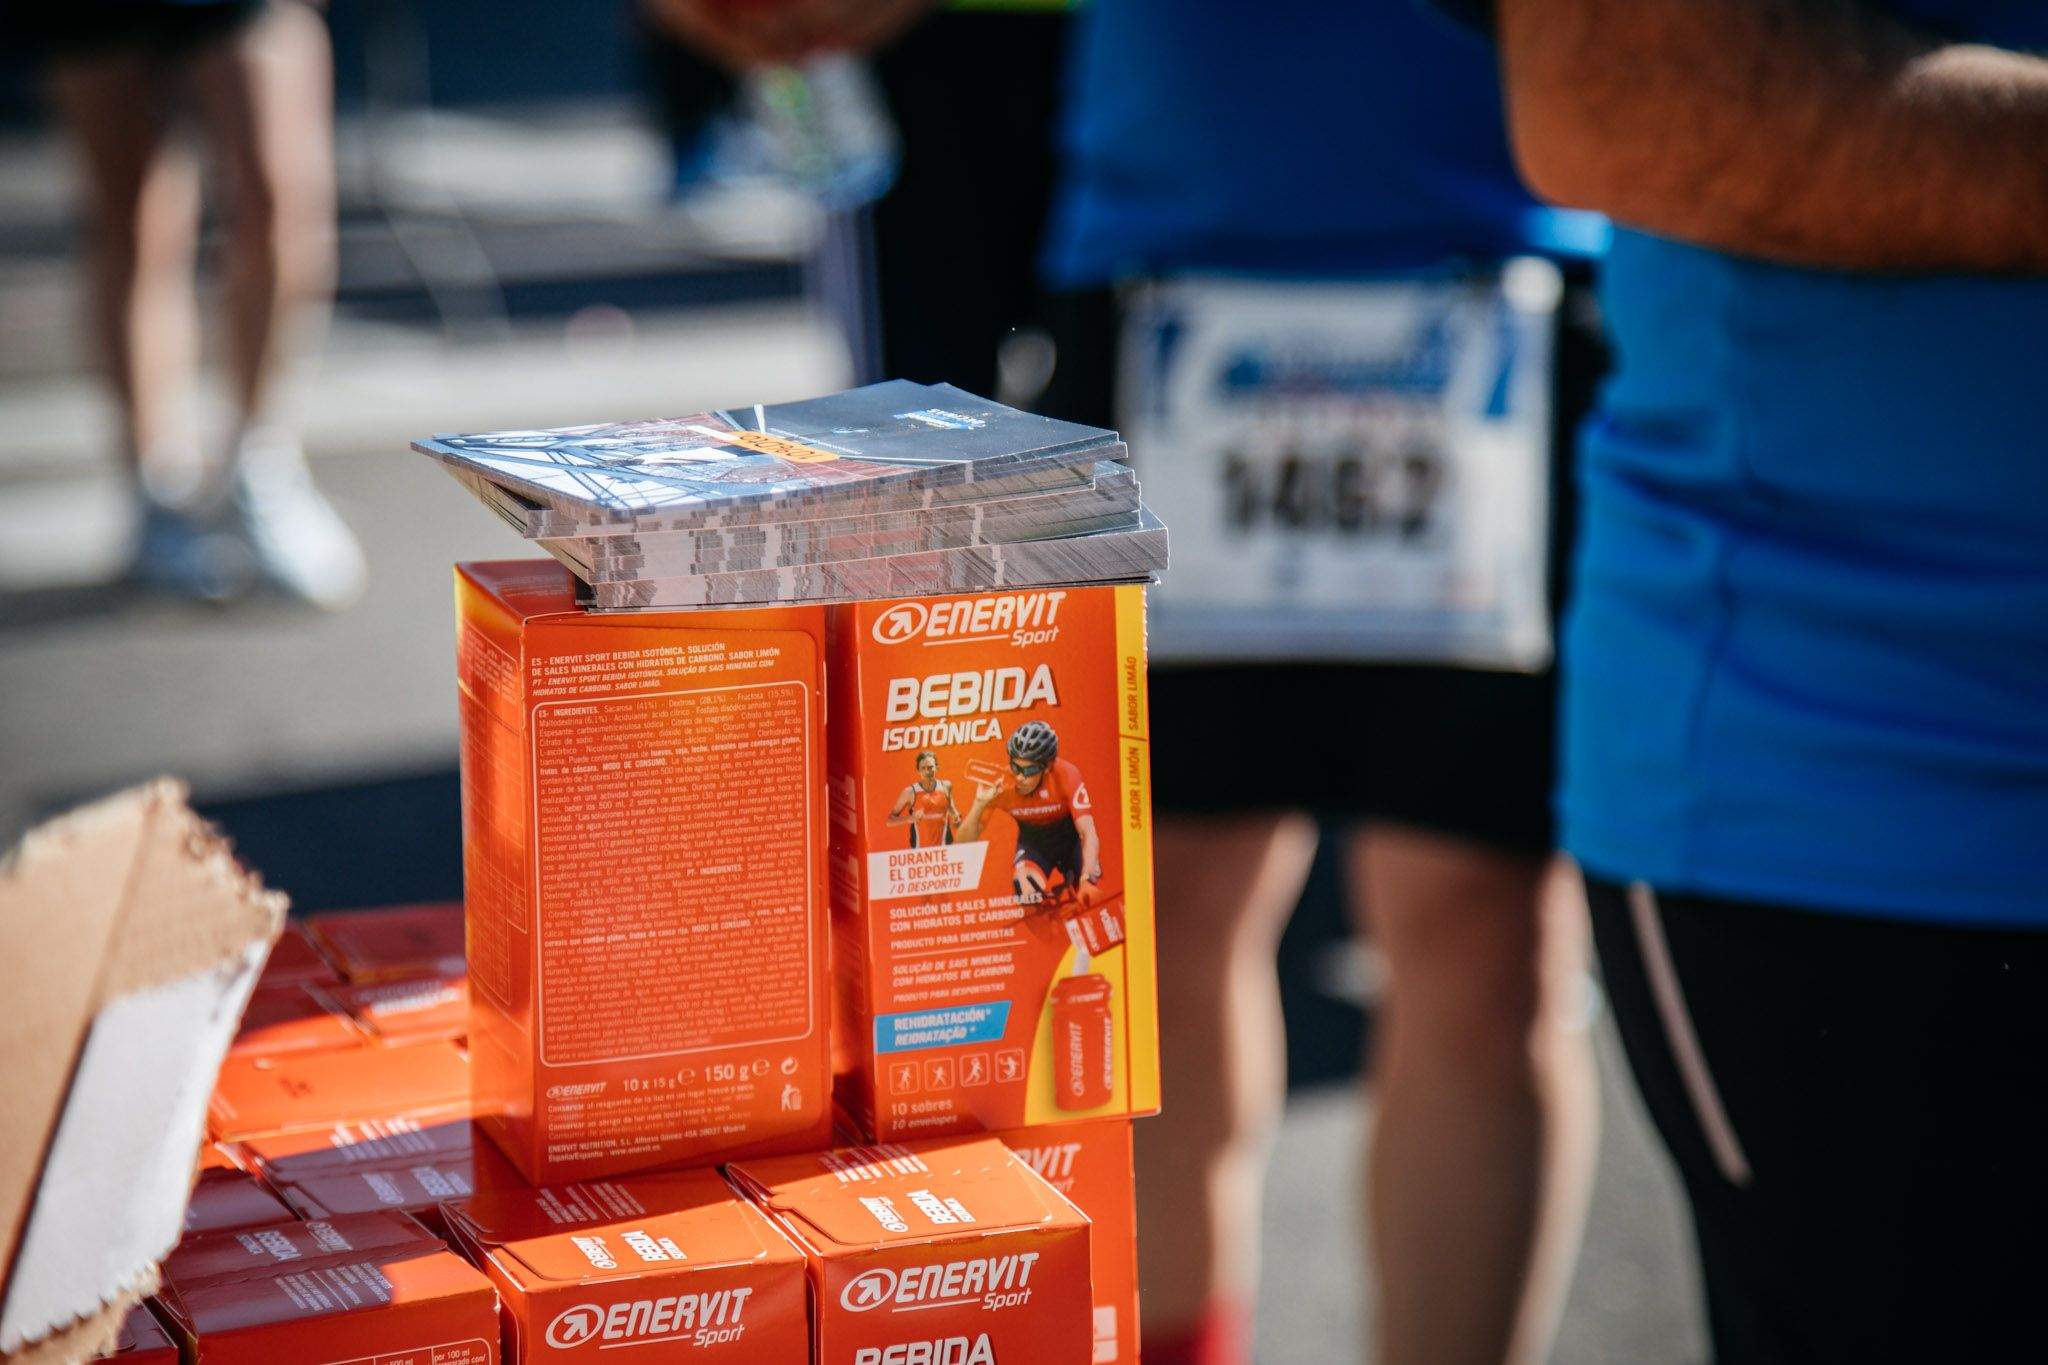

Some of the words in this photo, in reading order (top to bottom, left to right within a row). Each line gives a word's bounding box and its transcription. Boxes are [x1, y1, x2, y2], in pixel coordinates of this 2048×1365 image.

[925, 591, 1067, 637] ENERVIT
[1011, 626, 1059, 648] Sport
[531, 658, 541, 666] ES
[549, 654, 582, 664] ENERVIT
[585, 652, 610, 661] SPORT
[612, 650, 639, 659] BEBIDA
[642, 646, 685, 657] ISOTÓNICA.
[687, 643, 724, 653] SOLUCIÓN
[531, 668, 541, 676] DE
[544, 666, 568, 675] SALES
[571, 662, 615, 672] MINERALES
[617, 660, 634, 669] CON
[636, 657, 673, 667] HIDRATOS
[676, 656, 685, 664] DE
[688, 652, 725, 663] CARBONO.
[729, 650, 753, 659] SABOR
[756, 648, 779, 657] LIMÓN
[548, 676, 576, 684] ENERVIT
[578, 674, 600, 682] SPORT
[602, 672, 625, 680] BEBIDA
[666, 666, 697, 674] SOLUÇÃO
[709, 663, 724, 671] SAIS
[726, 661, 757, 669] MINERAIS
[759, 659, 774, 667] COM
[532, 687, 566, 696] HIDRATOS
[615, 681, 636, 689] SABOR
[886, 664, 1058, 722] BEBIDA
[1127, 695, 1138, 730] SABOR
[882, 717, 1003, 752] ISOTÓNICA
[1128, 747, 1140, 785] LIMÓN
[1130, 791, 1142, 829] SABOR
[889, 850, 948, 867] DURANTE
[889, 868, 905, 882] EL
[908, 863, 964, 879] DEPORTE
[908, 878, 961, 892] DESPORTO
[889, 901, 938, 920] SOLUCIÓN
[941, 902, 953, 915] DE
[955, 898, 986, 912] SALES
[988, 892, 1043, 910] MINERALES
[889, 920, 911, 933] CON
[913, 916, 962, 931] HIDRATOS
[964, 913, 977, 926] DE
[978, 908, 1025, 924] CARBONO
[890, 936, 934, 950] PRODUCTO
[936, 934, 959, 947] PARA
[961, 928, 1014, 943] DEPORTISTAS
[935, 958, 947, 970] DE
[948, 956, 970, 969] SAIS
[971, 953, 1013, 967] MINERAIS
[915, 971, 957, 986] HIDRATOS
[959, 969, 972, 981] DE
[973, 965, 1014, 979] CARBONO
[929, 989, 950, 1000] PARA
[704, 1062, 734, 1083] 150
[739, 1063, 749, 1081] g
[562, 1081, 606, 1096] ENERVIT
[623, 1078, 638, 1092] 10
[642, 1080, 649, 1090] x
[891, 1101, 906, 1116] 10
[911, 1098, 952, 1115] sobres
[549, 1143, 577, 1153] ENERVIT
[896, 1252, 1040, 1304] ENERVIT
[982, 1288, 1032, 1312] Sport
[602, 1287, 752, 1340] ENERVIT
[693, 1324, 745, 1348] Sport
